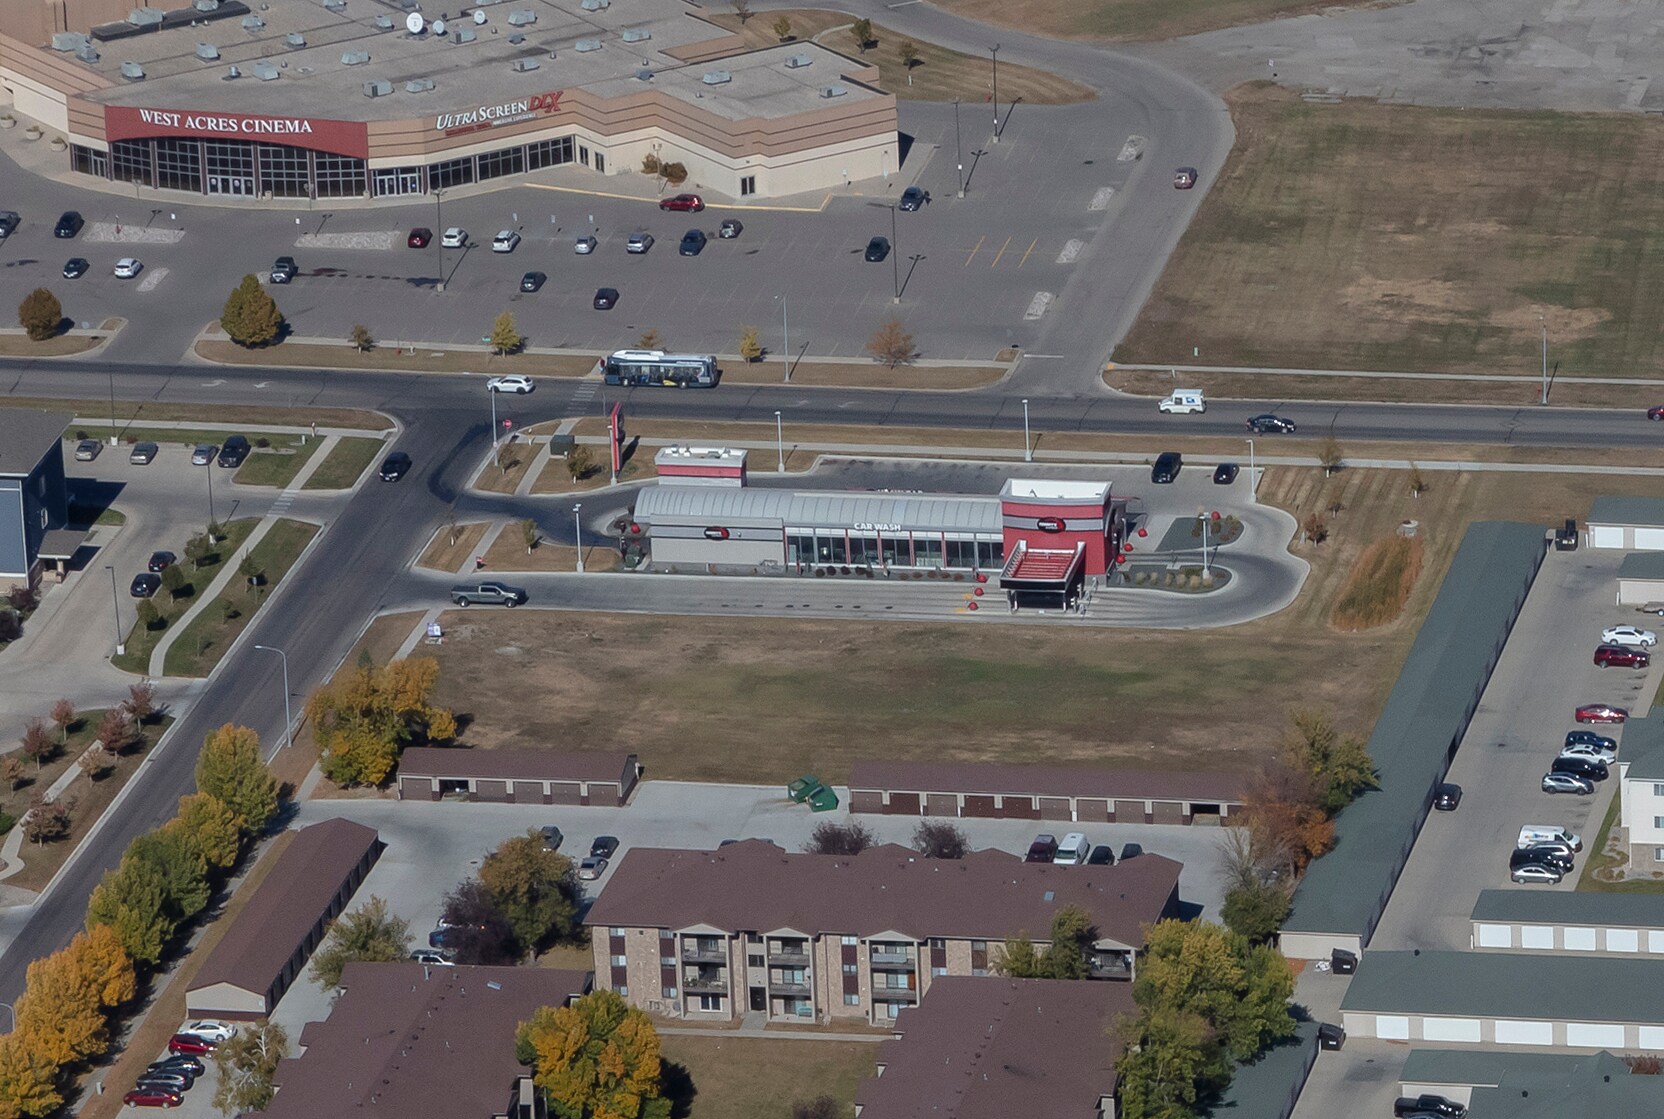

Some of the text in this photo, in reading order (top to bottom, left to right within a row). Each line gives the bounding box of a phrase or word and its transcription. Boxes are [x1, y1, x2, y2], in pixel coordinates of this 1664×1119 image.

[528, 91, 564, 114] DLX
[139, 109, 312, 133] WEST ACRES CINEMA
[854, 522, 901, 531] CAR WASH
